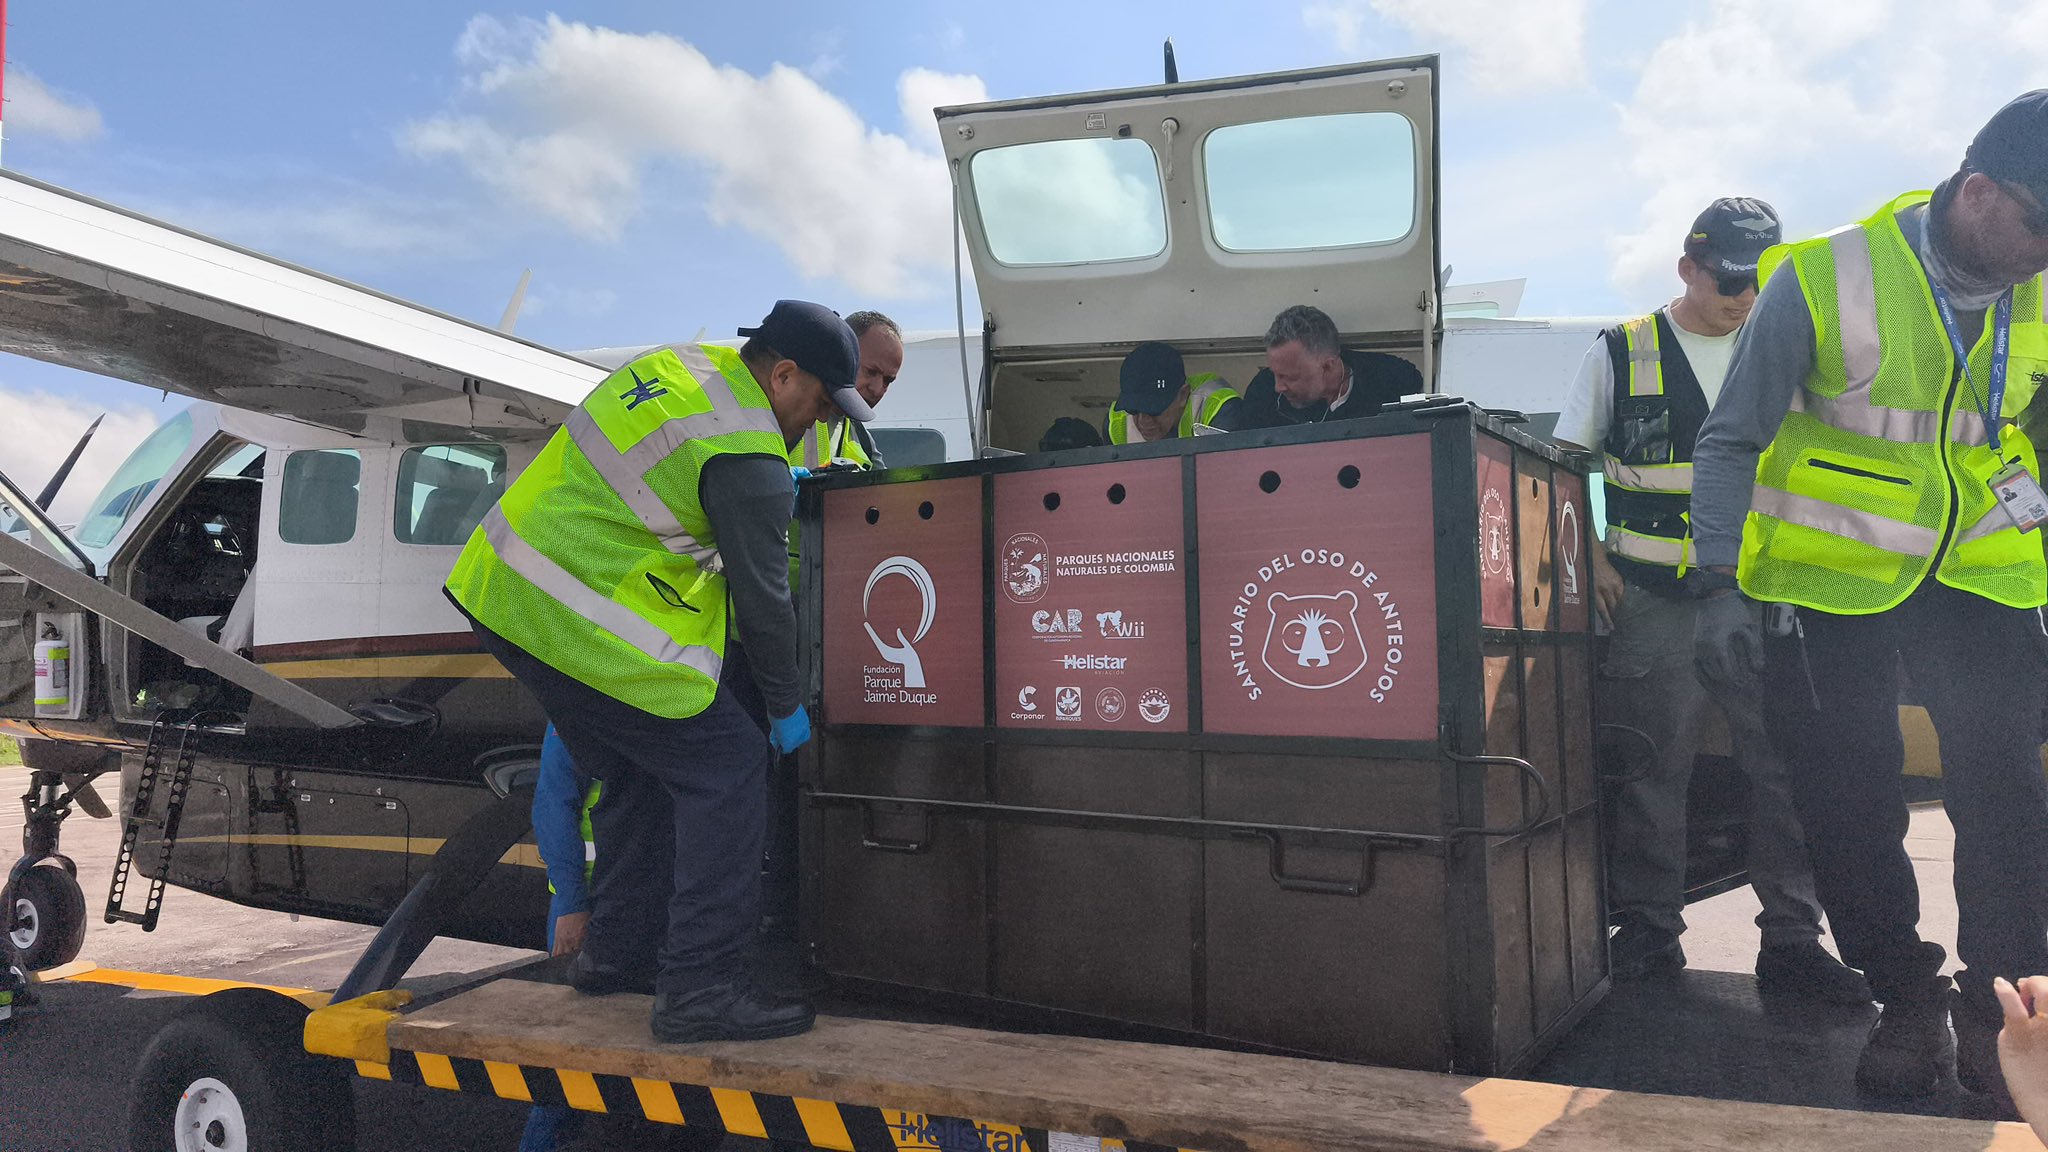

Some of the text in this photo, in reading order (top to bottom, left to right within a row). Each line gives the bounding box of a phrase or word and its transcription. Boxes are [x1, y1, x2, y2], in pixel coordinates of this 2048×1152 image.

[1056, 550, 1175, 565] PARQUES NACIONALES
[1056, 563, 1175, 576] NATURALES DE COLOMBIA
[1032, 609, 1083, 633] CAR
[1230, 549, 1403, 703] SANTUARIO DEL OSO DE ANTEOJOS
[863, 665, 901, 673] Fundación
[1064, 655, 1127, 669] Helistar
[864, 675, 901, 691] Parque
[864, 690, 937, 706] Jaime Duque
[1010, 712, 1045, 720] Corponor
